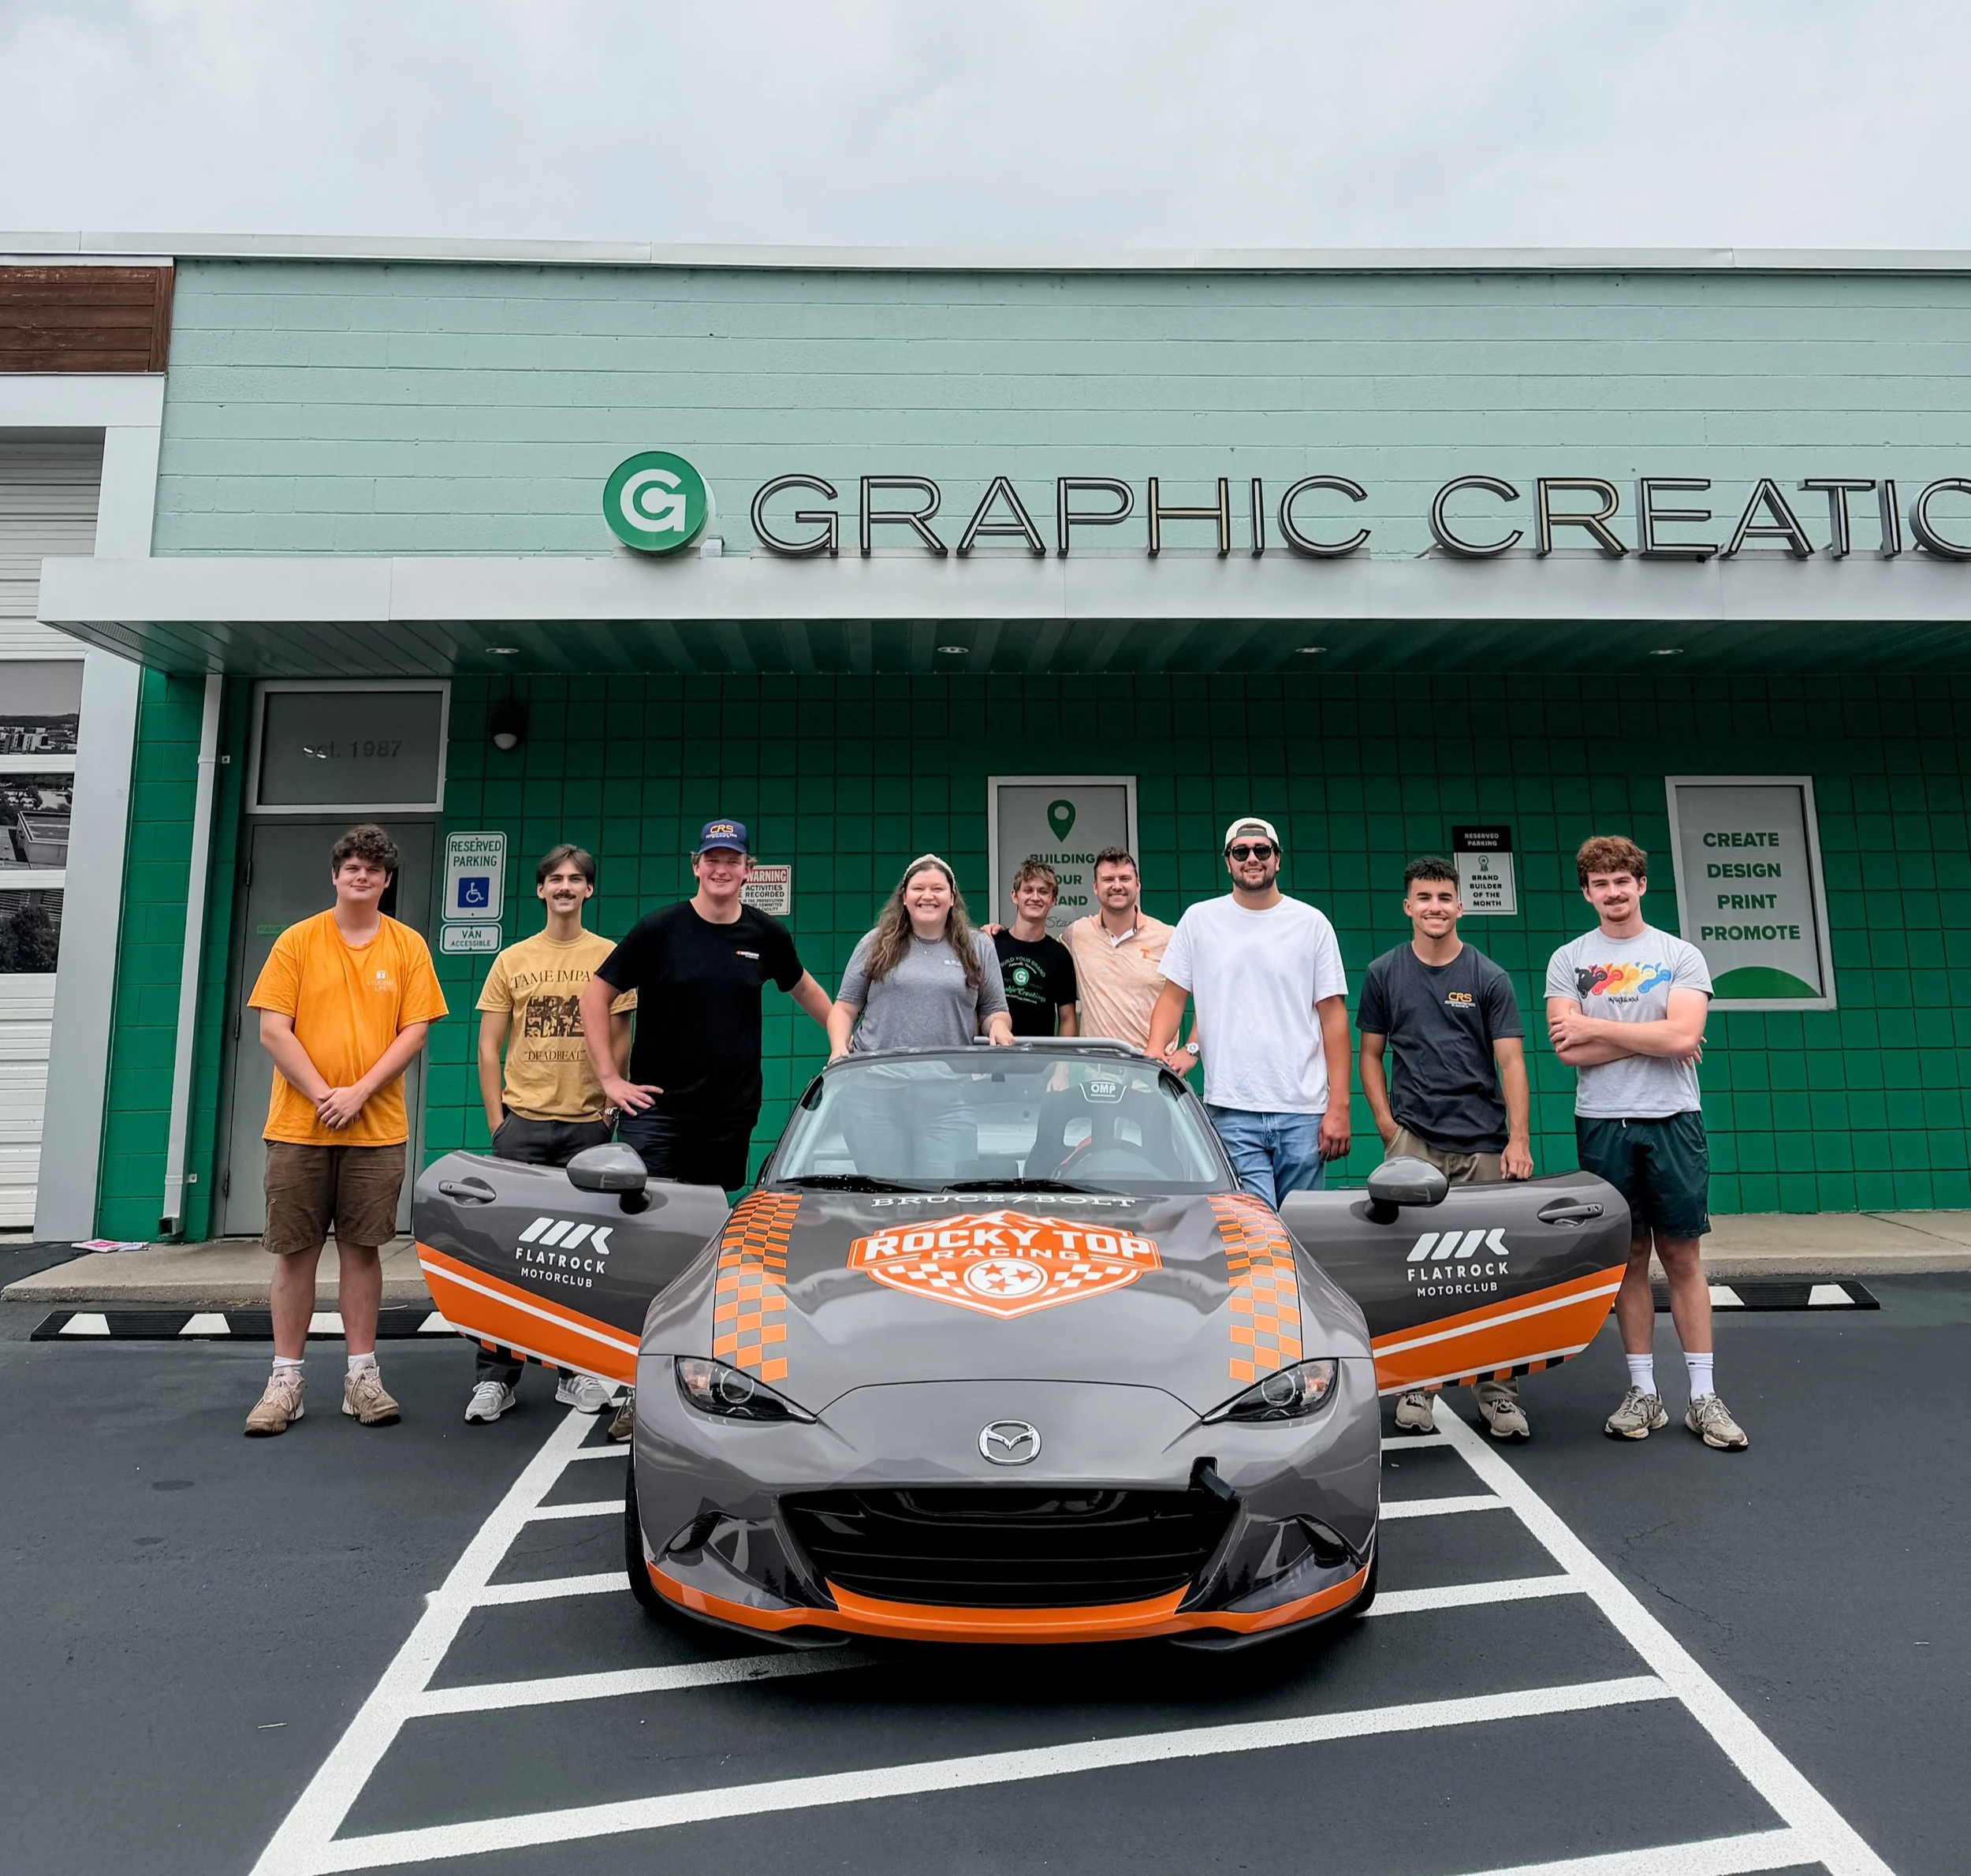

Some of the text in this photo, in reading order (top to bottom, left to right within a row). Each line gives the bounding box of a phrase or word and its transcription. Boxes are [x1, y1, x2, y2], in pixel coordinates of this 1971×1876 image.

[751, 473, 1371, 558] GRAPHIC
[349, 740, 403, 758] 1987
[710, 824, 734, 834] CRS
[451, 841, 501, 852] RESERVED
[1703, 833, 1779, 847] CREATE
[453, 856, 497, 867] PARKING
[747, 870, 787, 882] WARNING
[1707, 863, 1782, 878] DESIGN
[1056, 875, 1082, 885] OUR
[1055, 896, 1088, 905] AND
[1717, 894, 1777, 909] PRINT
[462, 930, 482, 938] VAN
[1701, 925, 1801, 941] PROMOTE
[511, 969, 591, 989] TAME IMPA
[1448, 991, 1473, 1002] CRS
[1090, 1083, 1116, 1094] OMP
[871, 1195, 1136, 1208] BRUCE BOLT
[865, 1228, 1151, 1261] ROCKY TOP
[515, 1247, 605, 1274] FLATROCK
[931, 1248, 1081, 1260] RACING
[520, 1266, 593, 1289] MOTORCLUB
[1407, 1262, 1509, 1281] FLATROCK
[1417, 1281, 1498, 1297] MOTORCLUB
